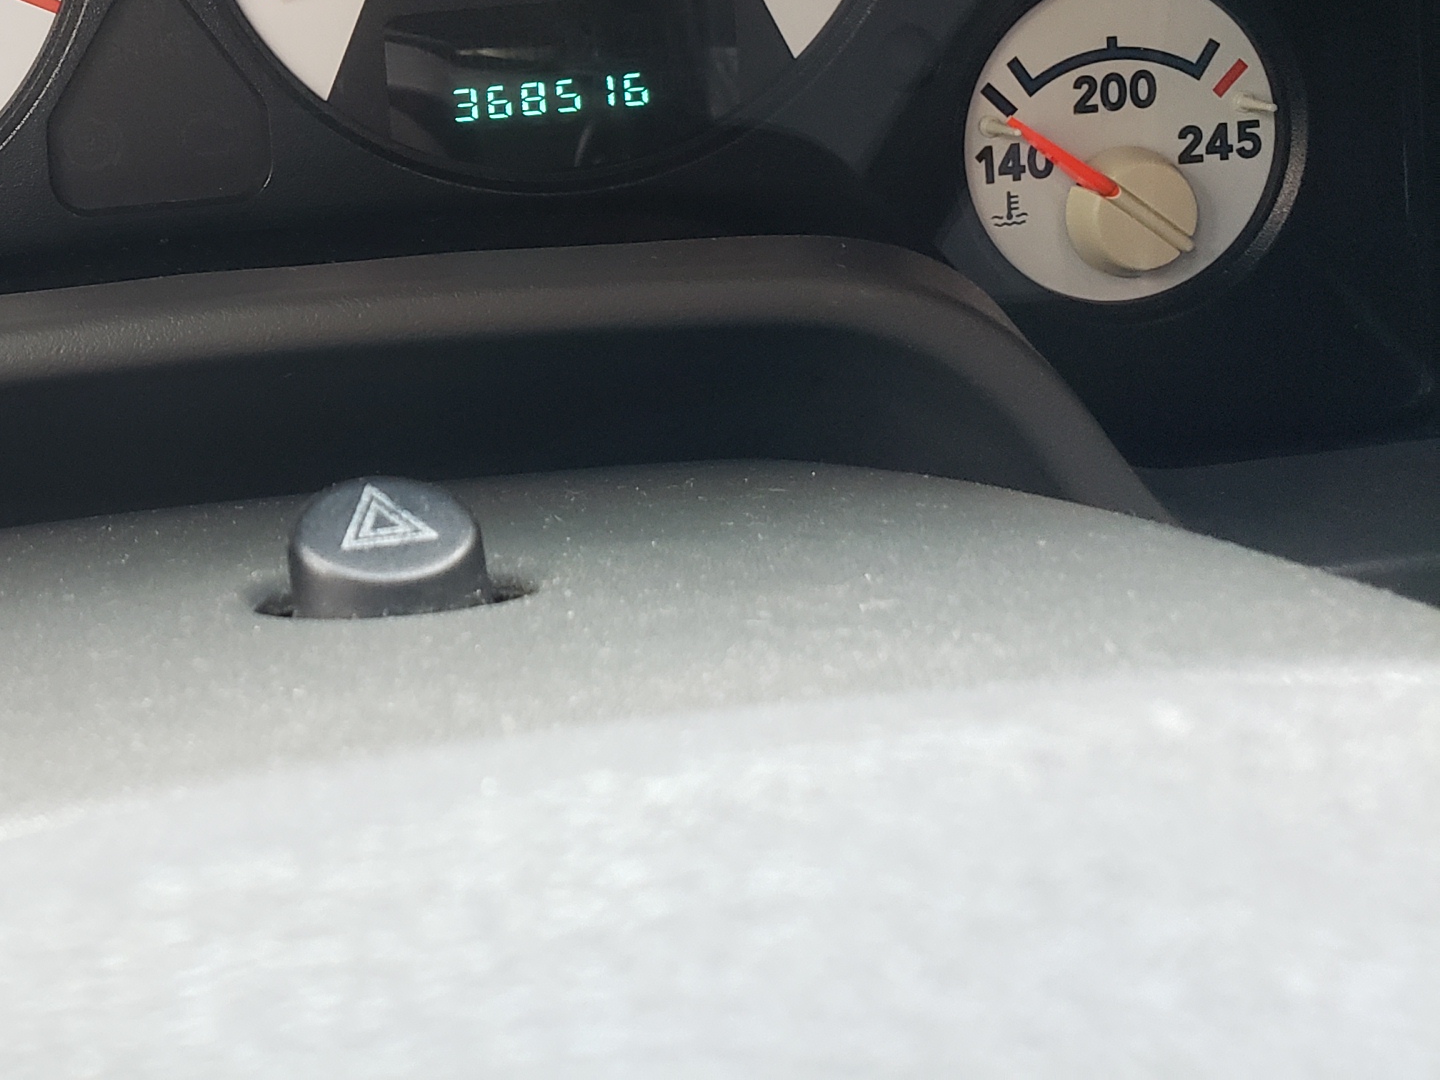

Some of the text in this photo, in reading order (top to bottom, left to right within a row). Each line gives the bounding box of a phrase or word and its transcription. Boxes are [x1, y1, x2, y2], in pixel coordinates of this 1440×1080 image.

[453, 73, 649, 122] 368516
[1073, 69, 1157, 115] 200
[975, 143, 1054, 185] 140
[1177, 120, 1262, 164] 245
